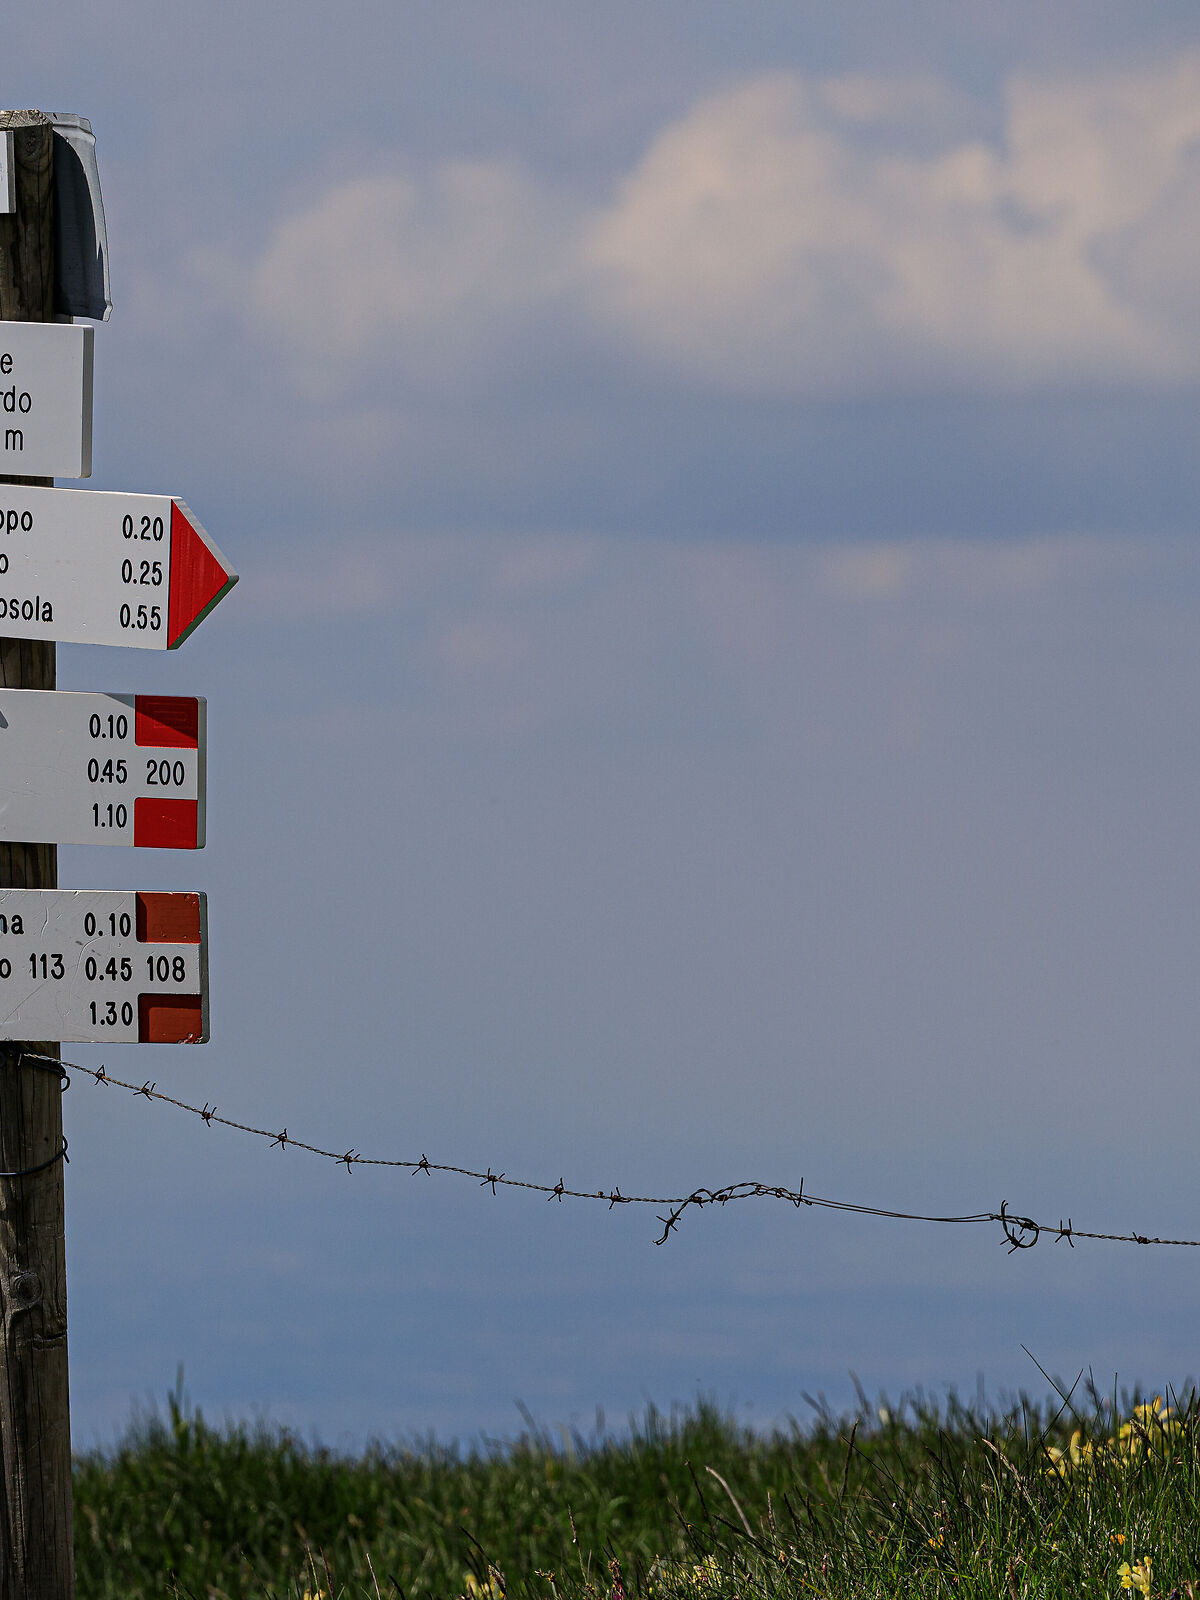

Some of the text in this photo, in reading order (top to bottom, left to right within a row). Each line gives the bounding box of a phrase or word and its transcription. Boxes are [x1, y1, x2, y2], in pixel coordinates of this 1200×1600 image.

[5, 429, 23, 451] m
[123, 515, 163, 541] 0.20
[122, 559, 162, 586] 0.25
[120, 604, 161, 630] 0.55
[89, 714, 128, 739] 0.10
[88, 759, 127, 784] 0.45
[147, 760, 184, 786] 200
[93, 803, 127, 828] 1.10
[84, 912, 131, 937] 0.10
[29, 953, 65, 979] 113
[85, 957, 132, 981] 0.45
[147, 956, 185, 982] 108
[90, 1001, 133, 1026] 1.30
